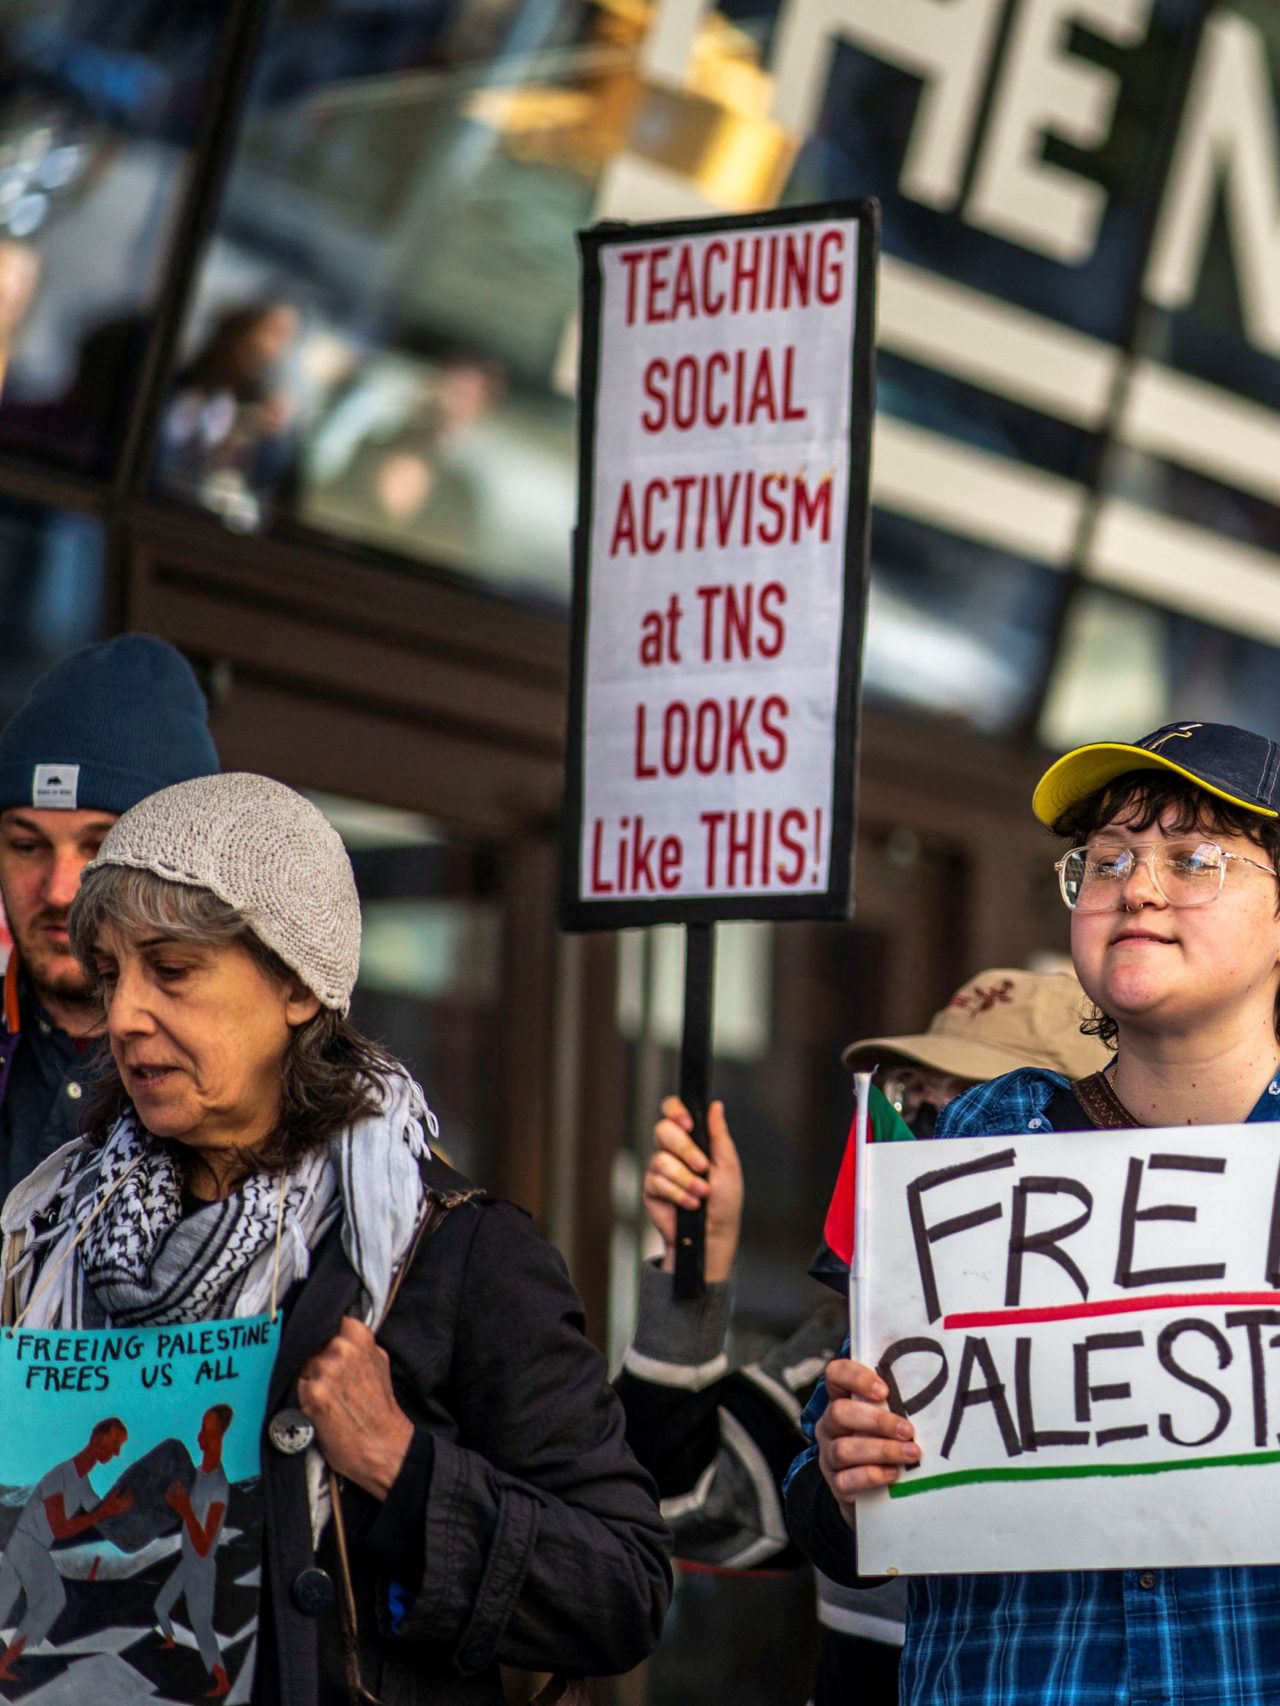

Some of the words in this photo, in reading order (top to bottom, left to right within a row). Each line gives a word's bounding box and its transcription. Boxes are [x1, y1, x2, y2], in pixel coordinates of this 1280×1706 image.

[619, 229, 846, 328] TEACHING
[641, 344, 808, 435] SOCIAL
[609, 468, 833, 558] ACTIVISM
[640, 593, 683, 667] at
[697, 581, 788, 662] TNS
[634, 694, 790, 781] LOOKS
[591, 815, 684, 894] Like
[700, 807, 823, 889] THIS!
[16, 1333, 145, 1363] FREEING
[157, 1322, 272, 1358] PALESTINE
[26, 1364, 110, 1392] FREES
[141, 1361, 173, 1389] US
[194, 1356, 240, 1385] ALL
